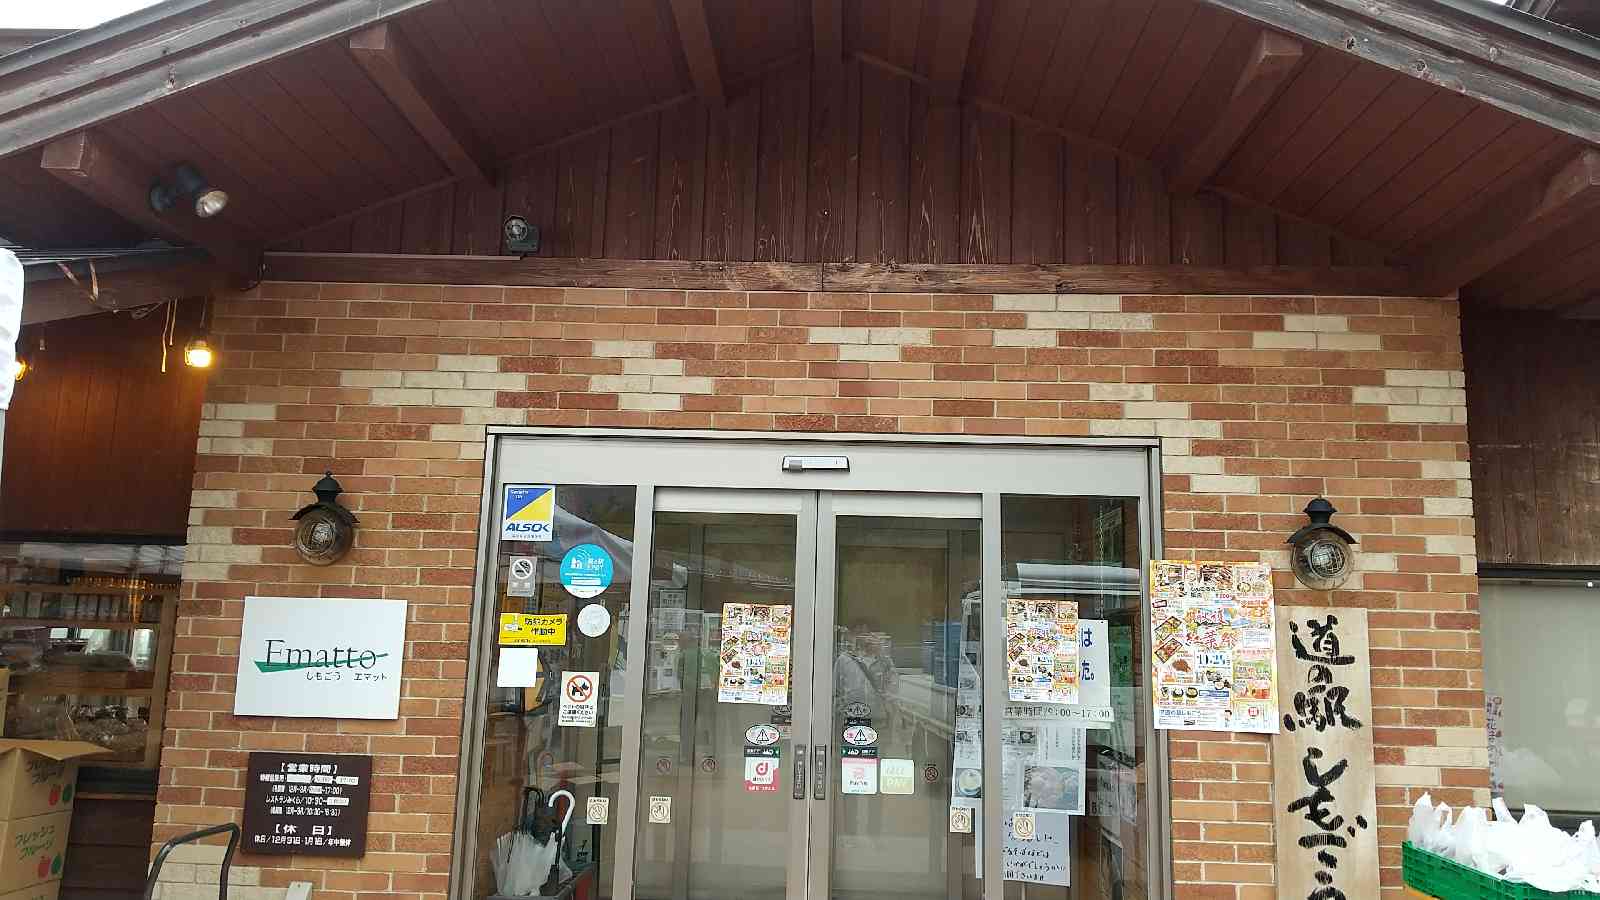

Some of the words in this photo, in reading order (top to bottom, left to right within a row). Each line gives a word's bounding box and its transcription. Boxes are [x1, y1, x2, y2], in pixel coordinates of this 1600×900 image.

[505, 523, 551, 532] ALSOK
[264, 639, 377, 670] Ematto
[305, 671, 342, 681] しもごう
[353, 672, 389, 681] エマット
[1283, 614, 1363, 732] 道の駅
